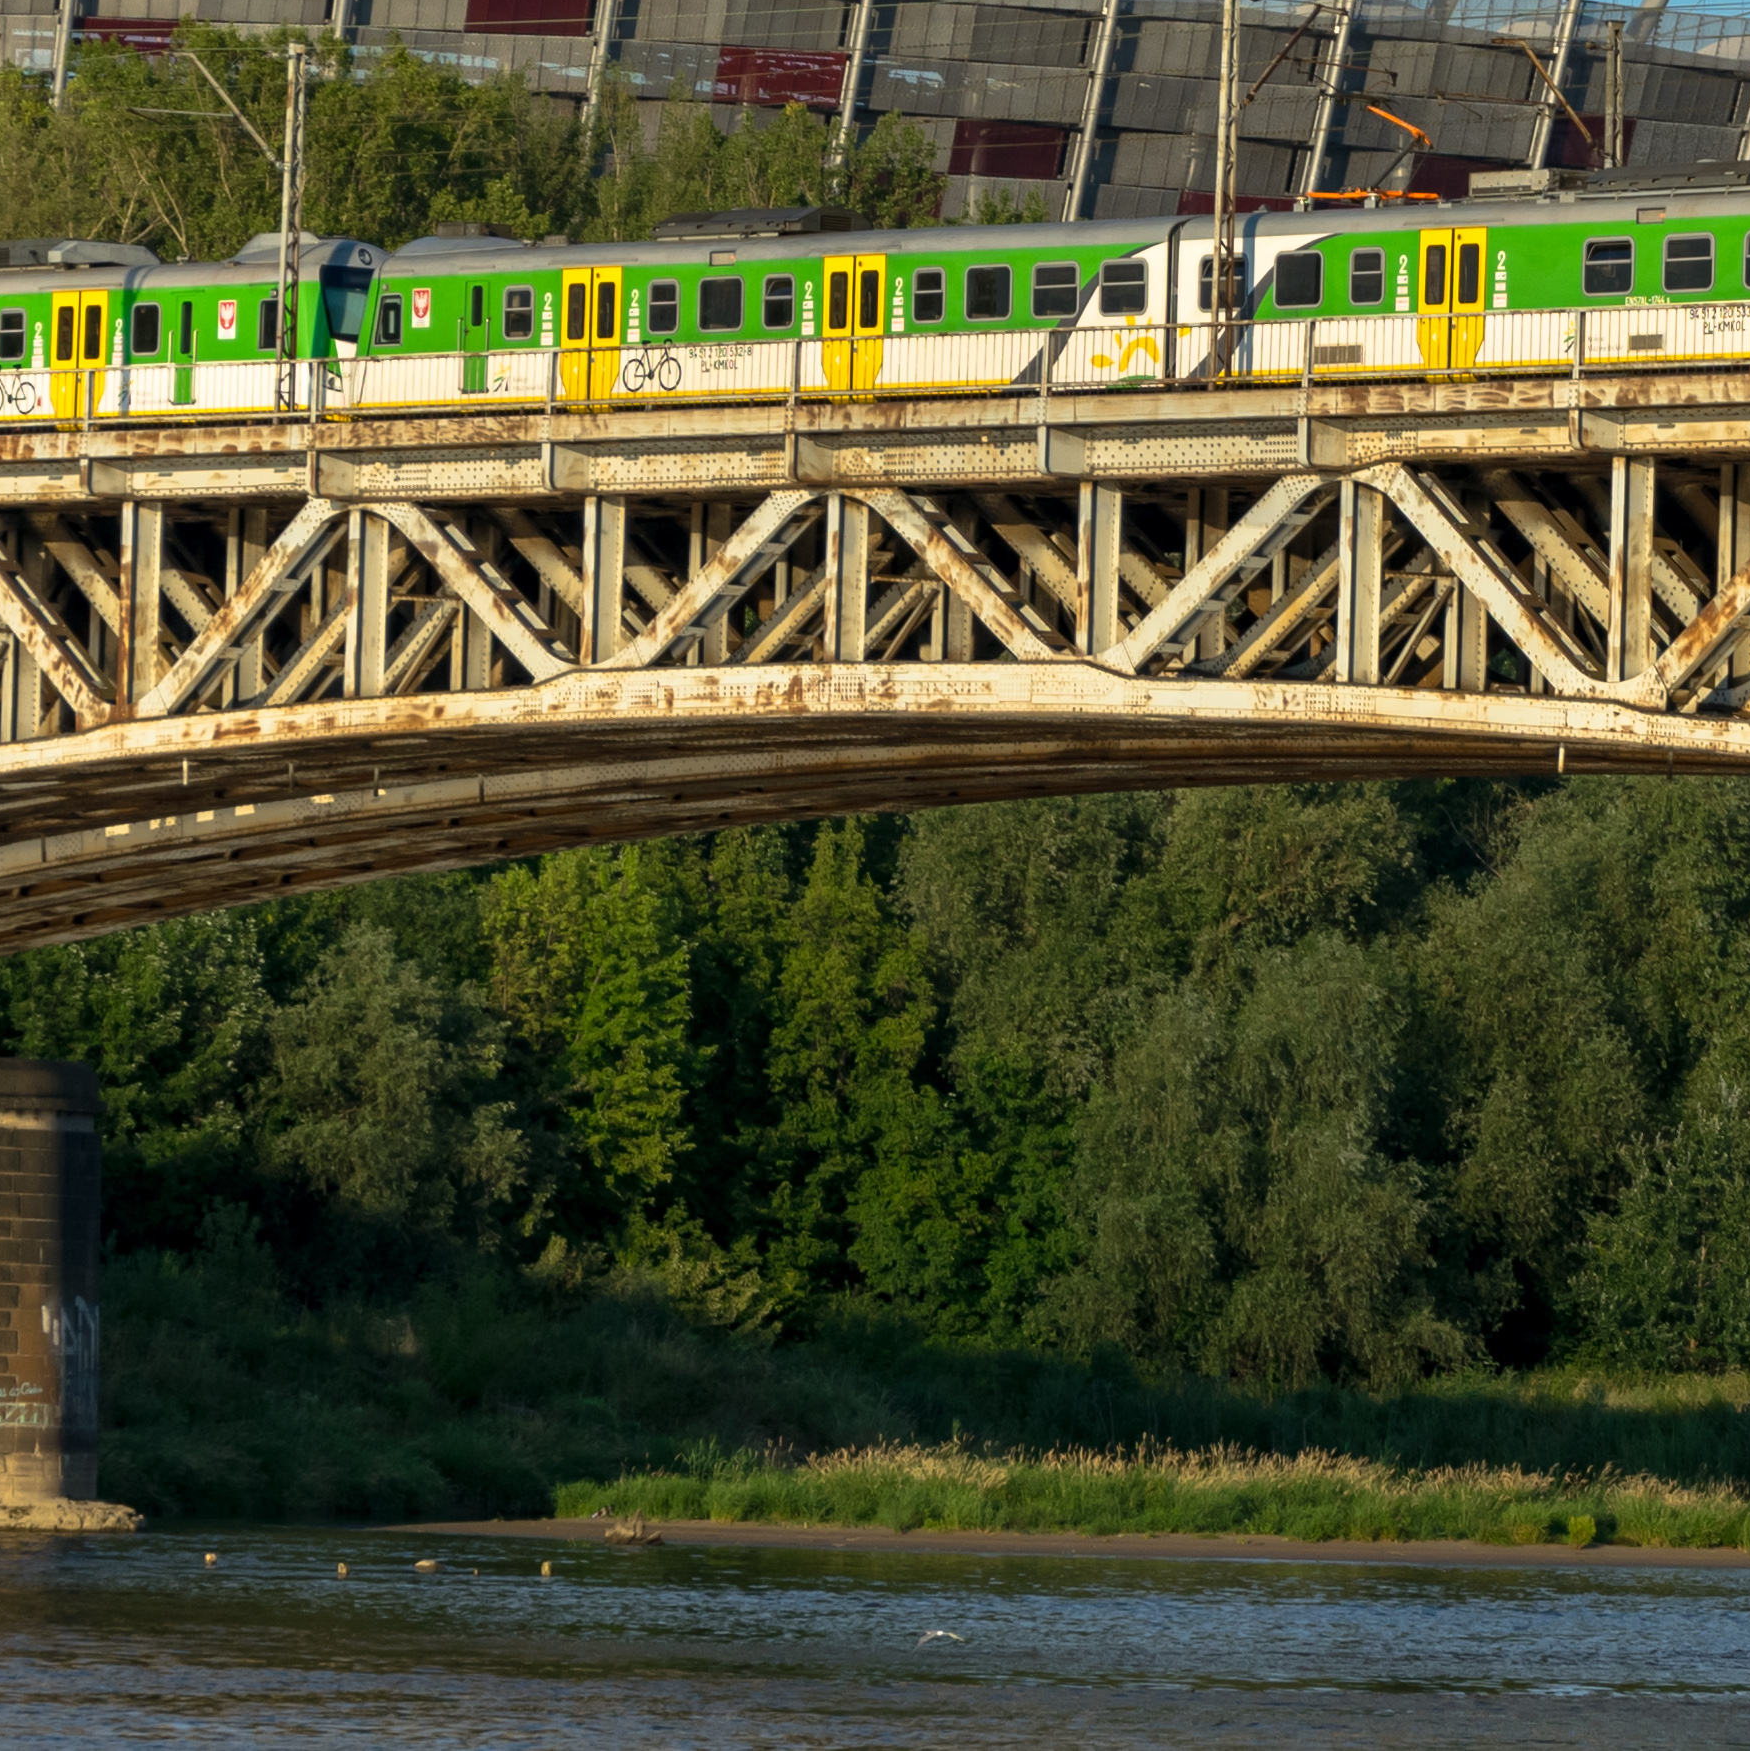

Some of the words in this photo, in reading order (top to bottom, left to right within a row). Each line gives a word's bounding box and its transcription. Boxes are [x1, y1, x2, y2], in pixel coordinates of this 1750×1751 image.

[1399, 254, 1408, 274] 2
[1497, 250, 1506, 270] 2
[804, 281, 813, 300] 2
[895, 277, 903, 296] 2
[543, 292, 552, 311] 2
[631, 289, 639, 308] 2
[34, 321, 42, 338] 2
[115, 318, 123, 335] 2
